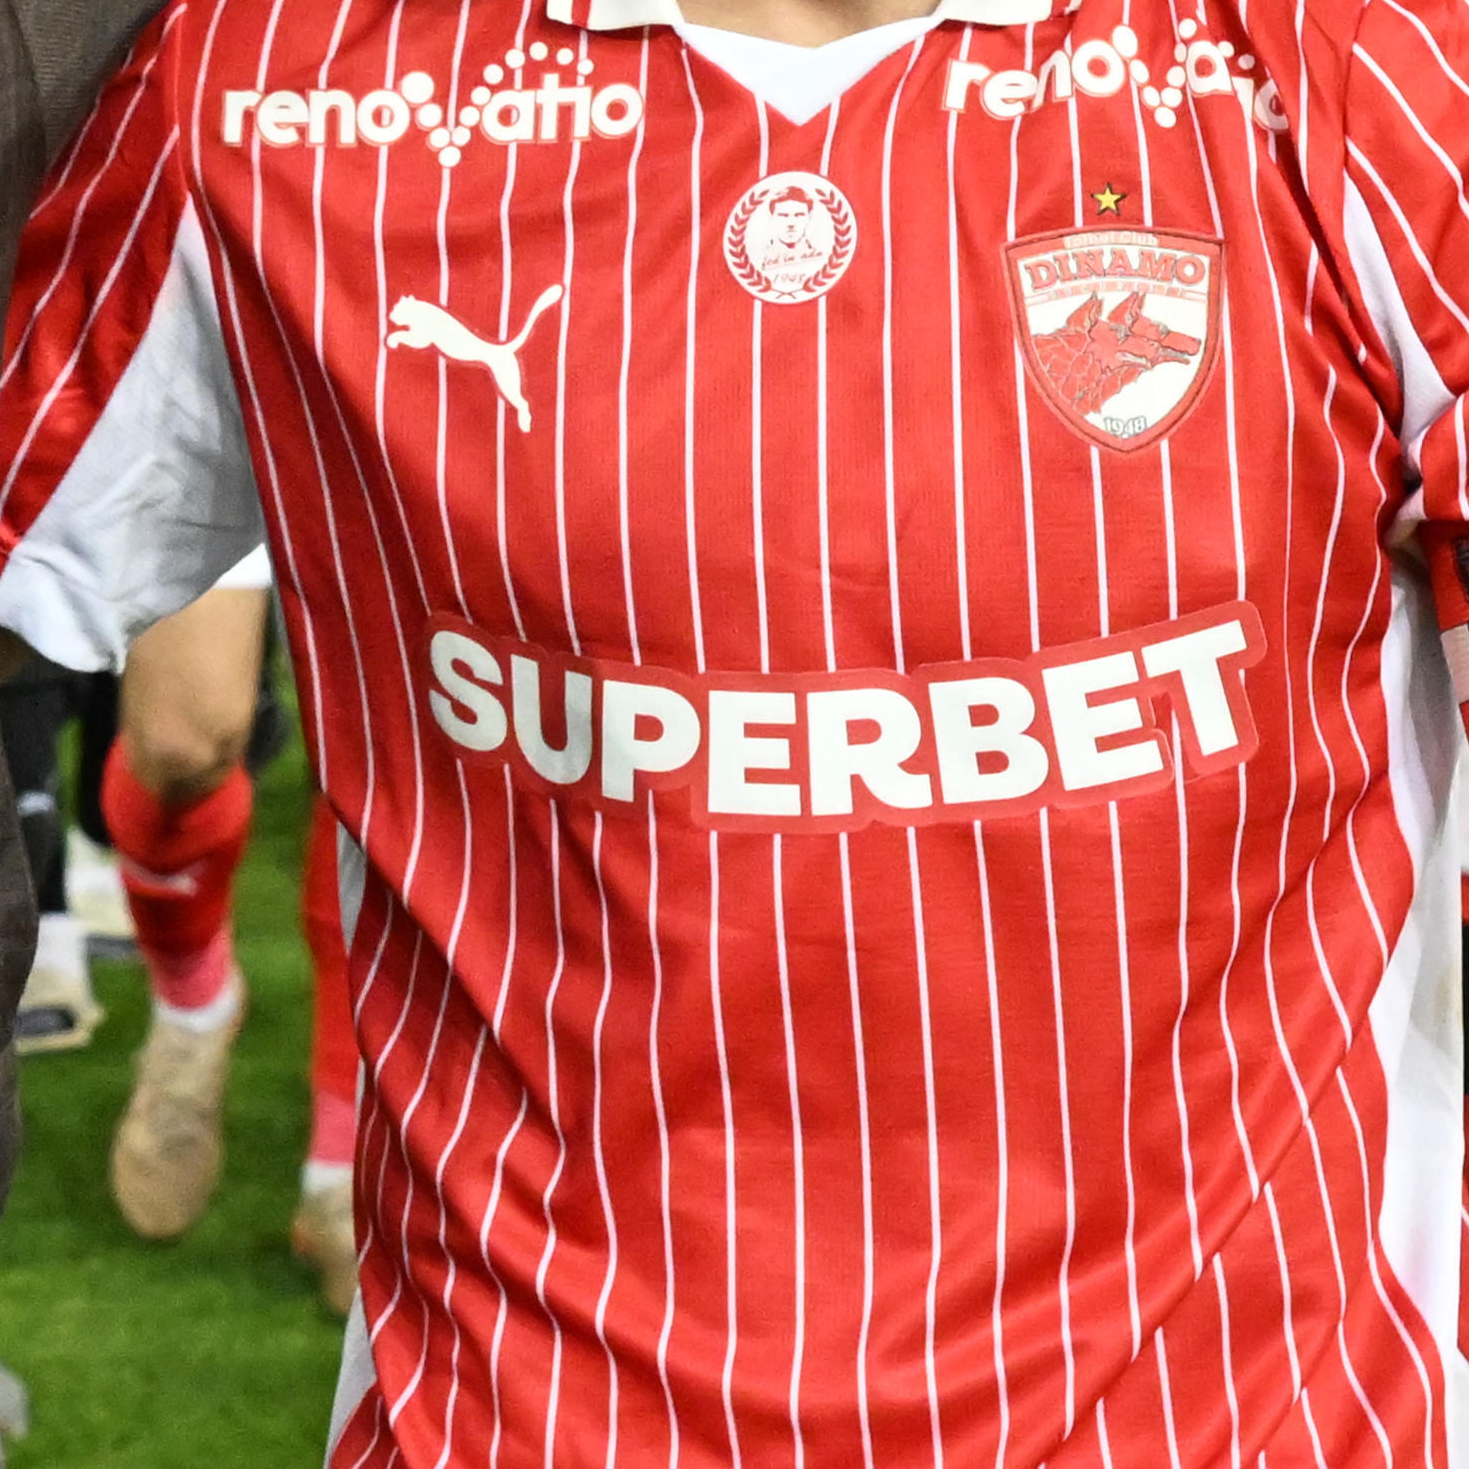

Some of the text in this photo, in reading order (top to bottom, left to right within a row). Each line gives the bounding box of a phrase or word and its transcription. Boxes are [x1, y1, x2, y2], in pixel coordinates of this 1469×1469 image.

[220, 39, 644, 169] renovatio
[1026, 248, 1207, 290] DINAMO
[428, 619, 1249, 817] SUPERBET
